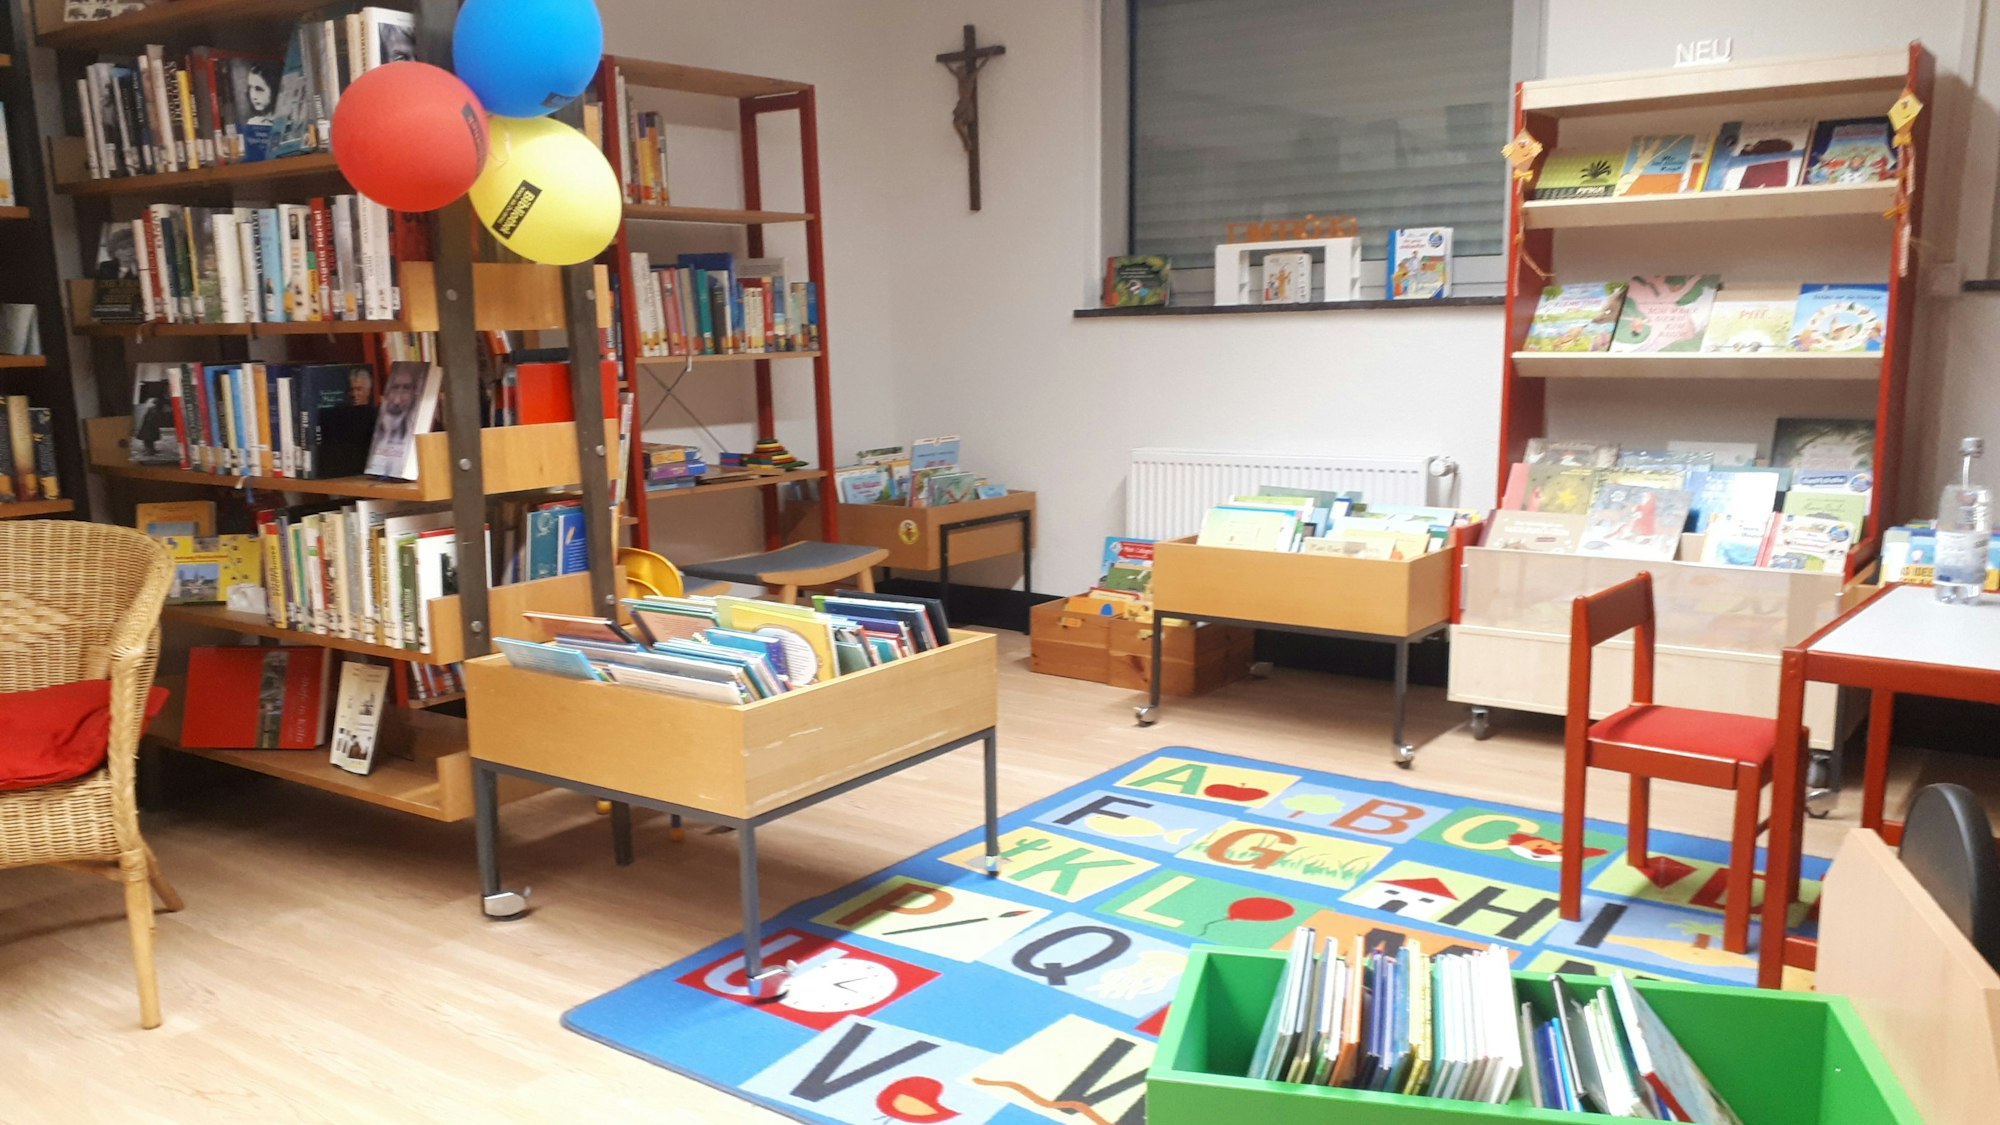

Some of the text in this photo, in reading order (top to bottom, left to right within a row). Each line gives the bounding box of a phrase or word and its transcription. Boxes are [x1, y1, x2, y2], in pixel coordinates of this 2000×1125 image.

[1673, 37, 1732, 67] NEU
[313, 210, 330, 288] Angela Merkel
[1126, 763, 1208, 795] A
[1052, 795, 1154, 825] F
[1329, 798, 1426, 835] B
[1441, 814, 1541, 850] C
[1206, 828, 1297, 869] G
[1008, 847, 1136, 896] K
[833, 883, 955, 927] P
[1115, 875, 1197, 928] L
[1437, 886, 1561, 940] H
[1575, 902, 1628, 948] I
[1012, 925, 1132, 985] Q
[789, 1022, 941, 1103] V
